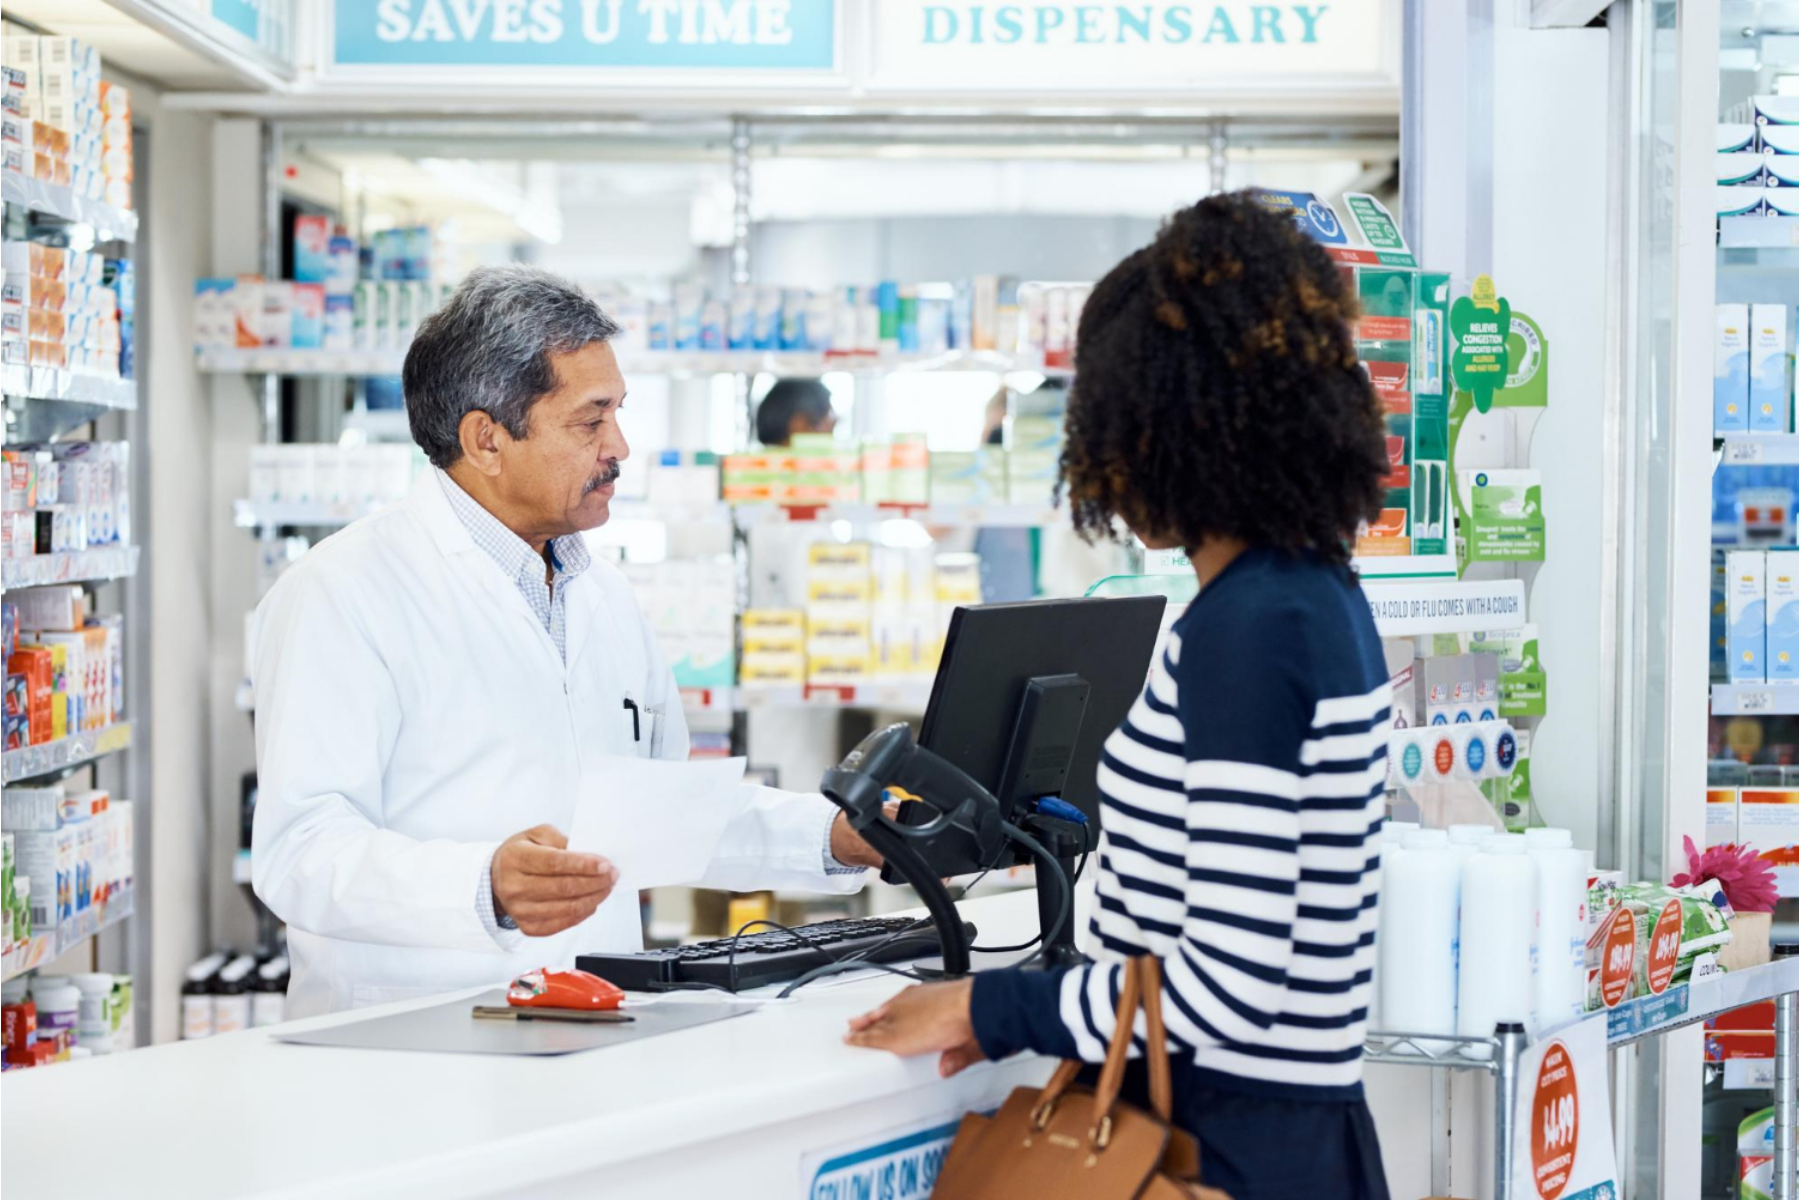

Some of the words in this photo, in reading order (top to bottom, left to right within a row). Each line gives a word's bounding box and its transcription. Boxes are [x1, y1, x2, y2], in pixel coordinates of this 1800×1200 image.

[375, 0, 565, 43] SAVES
[580, 0, 621, 44] U
[638, 0, 793, 45] TIME
[921, 5, 1331, 45] DISPENSARY
[1462, 334, 1502, 345] CONGESTION
[1470, 323, 1498, 333] RELIEVES
[1509, 319, 1538, 345] CRIBED
[1370, 601, 1381, 619] EN
[1382, 601, 1387, 618] A
[1388, 600, 1408, 618] COLD
[1411, 600, 1421, 618] OR
[1422, 599, 1436, 617] FLU
[1438, 598, 1464, 617] COMES
[1466, 597, 1486, 615] WITH
[1487, 597, 1492, 614] A
[1493, 595, 1519, 614] COUGH
[877, 1160, 895, 1200] US
[900, 1155, 919, 1198] ON
